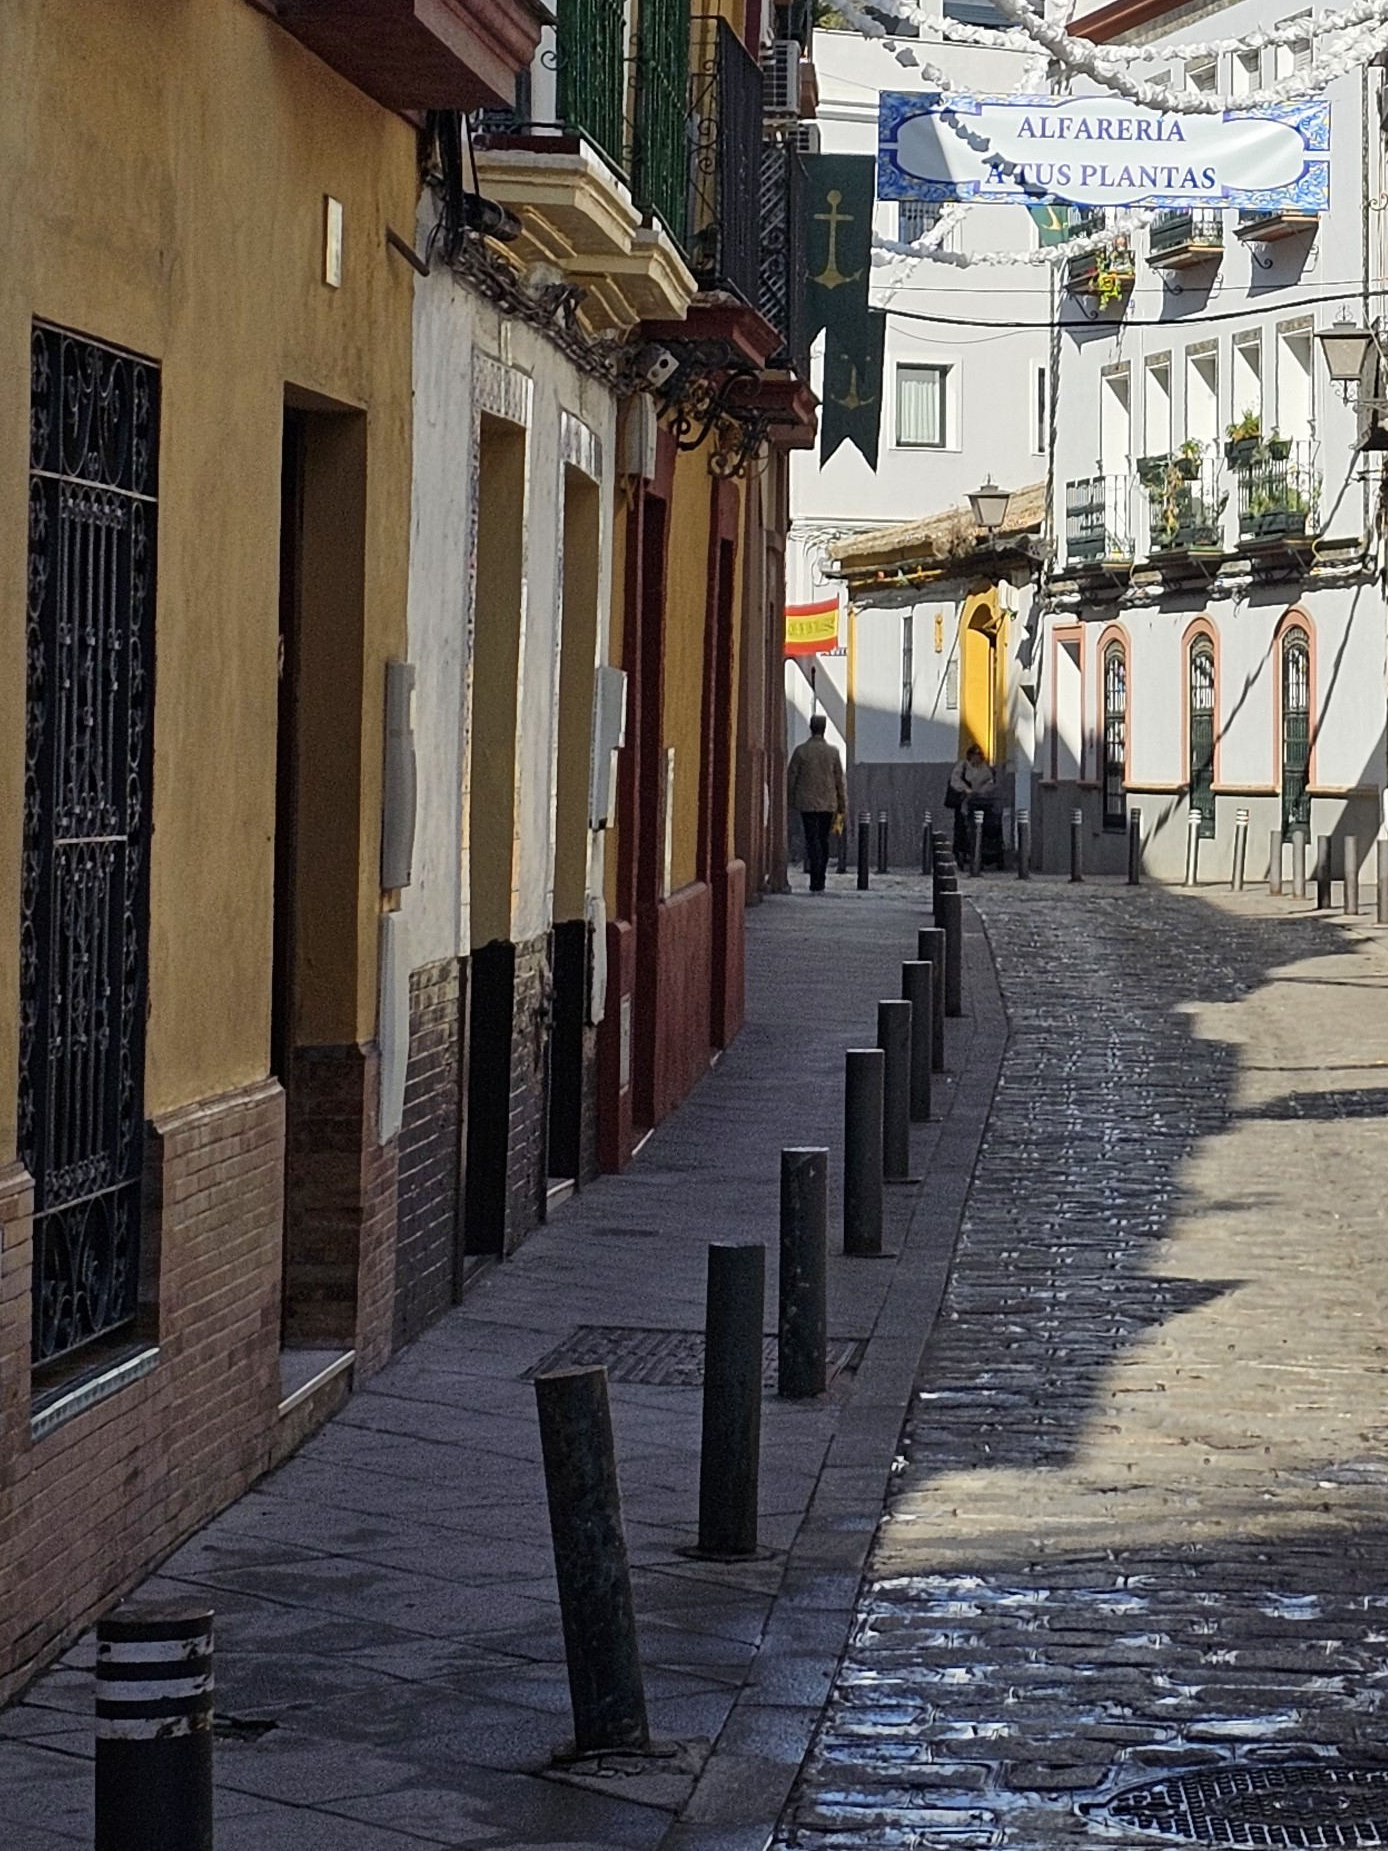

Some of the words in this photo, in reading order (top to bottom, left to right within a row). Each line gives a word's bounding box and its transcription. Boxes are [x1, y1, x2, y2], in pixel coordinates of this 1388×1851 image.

[984, 160, 1007, 185] A
[1014, 162, 1072, 187] TUS
[1079, 163, 1217, 190] PLANTAS
